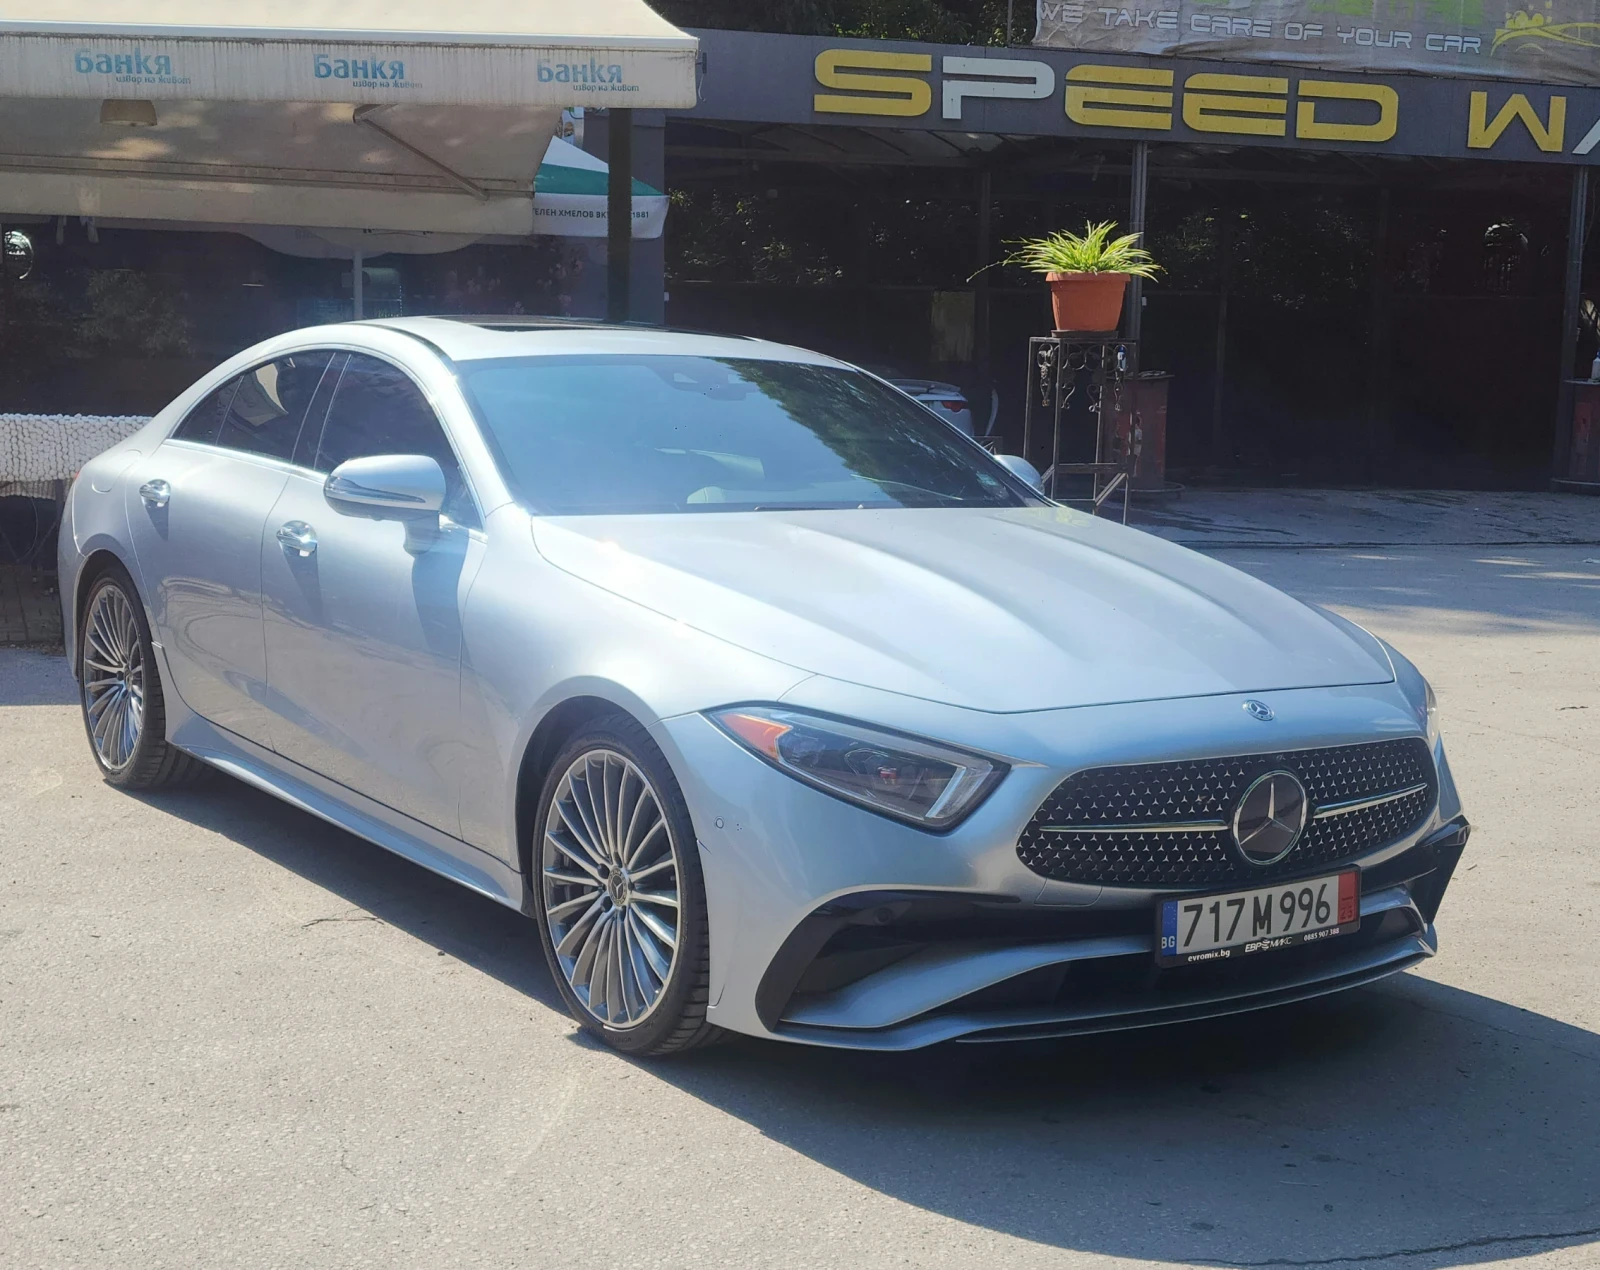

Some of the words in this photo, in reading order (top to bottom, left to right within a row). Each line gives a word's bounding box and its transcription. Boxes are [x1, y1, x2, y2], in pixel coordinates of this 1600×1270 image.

[1040, 3, 1084, 23] WE
[1097, 7, 1178, 29] TAKE
[1190, 14, 1272, 38] CARE
[1285, 22, 1323, 41] OF
[1336, 26, 1413, 49] YOUR
[1425, 33, 1481, 54] CAR
[75, 48, 171, 75] Банкя
[313, 53, 405, 80] Банкя
[537, 56, 623, 83] Банкя
[352, 80, 377, 89] извор
[573, 83, 596, 92] извор
[814, 49, 1399, 142] SPEED
[558, 210, 594, 218] ХМЕЛОВ
[1162, 936, 1176, 949] BG
[1188, 949, 1231, 962] evromix.bg
